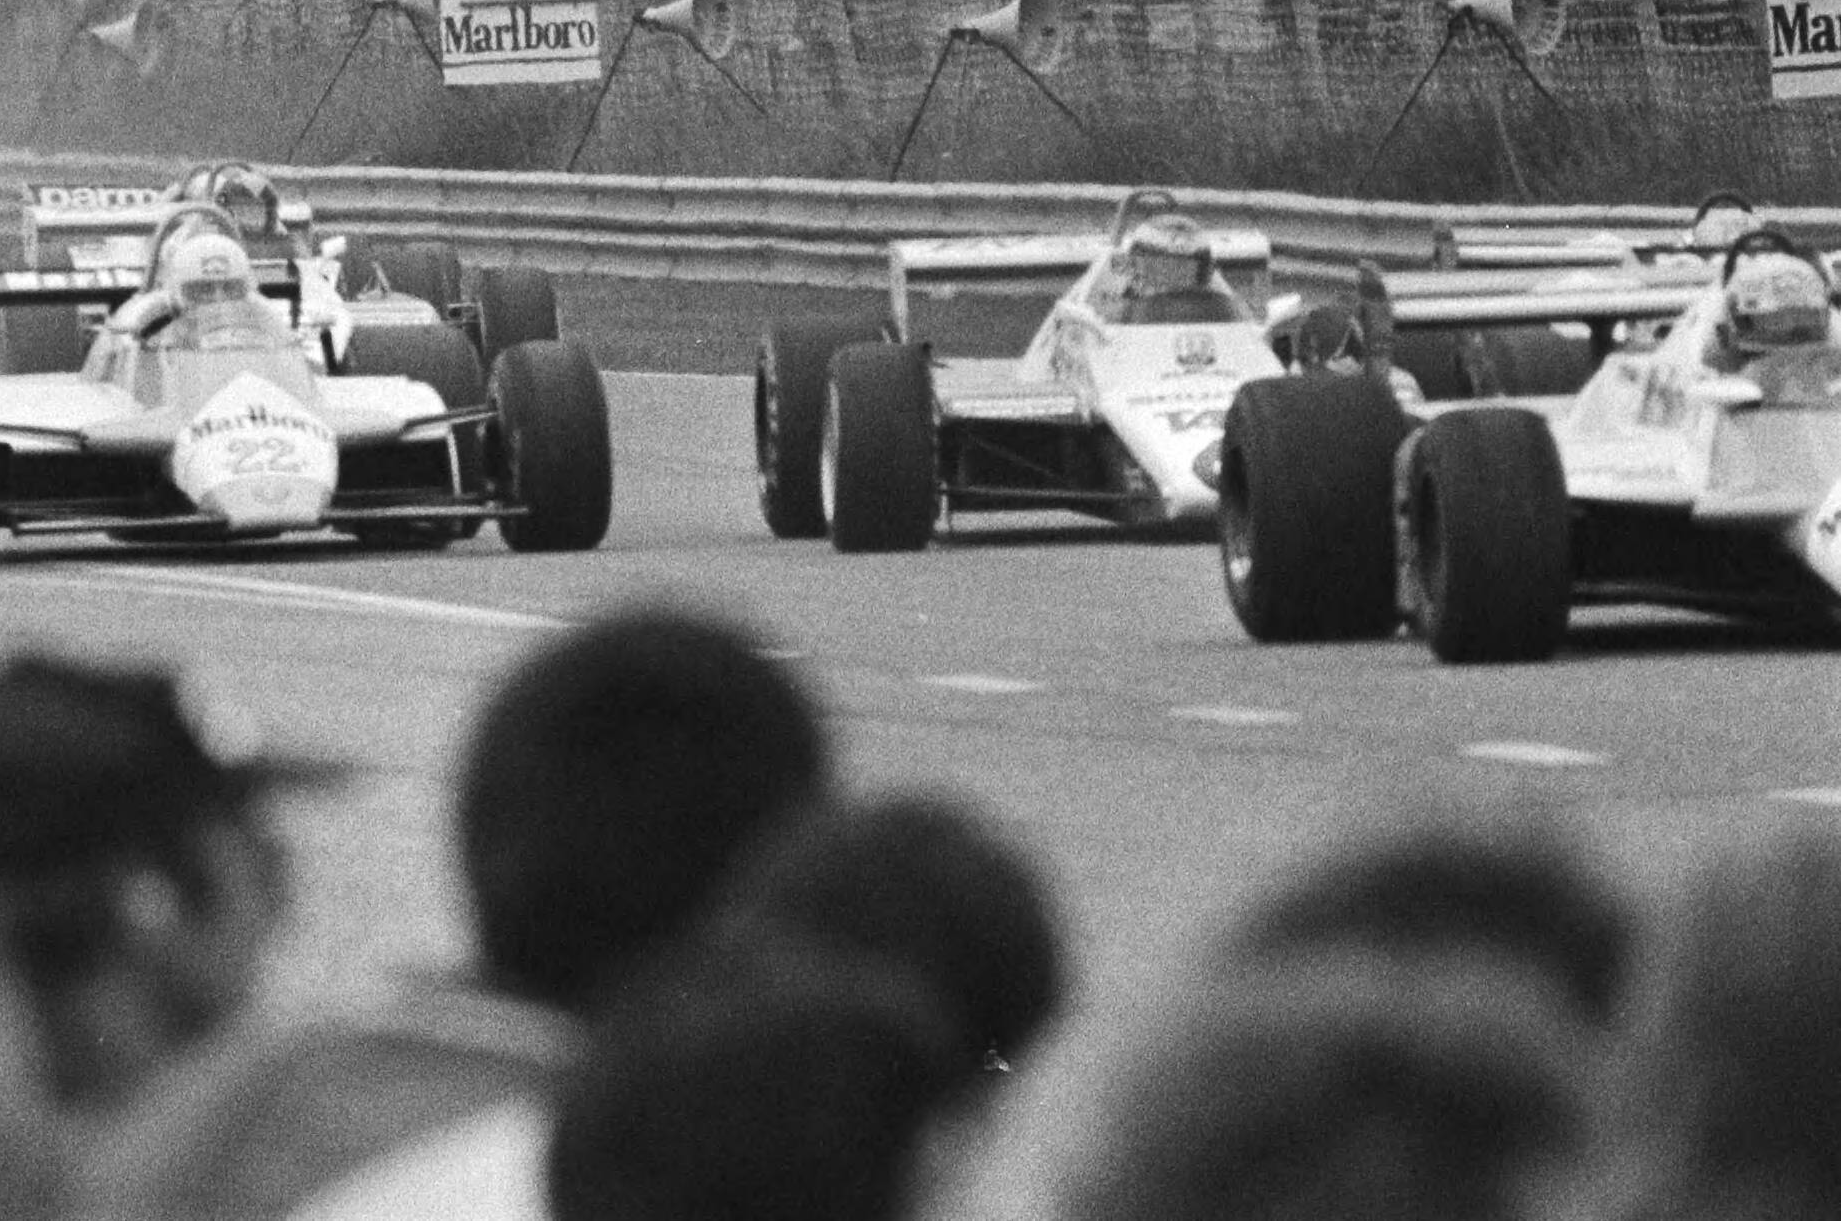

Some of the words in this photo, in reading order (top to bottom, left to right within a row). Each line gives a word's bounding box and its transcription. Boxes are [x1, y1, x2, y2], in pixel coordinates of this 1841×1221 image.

[444, 3, 595, 54] Marlboro
[1770, 1, 1841, 57] Ma
[227, 435, 302, 474] 22
